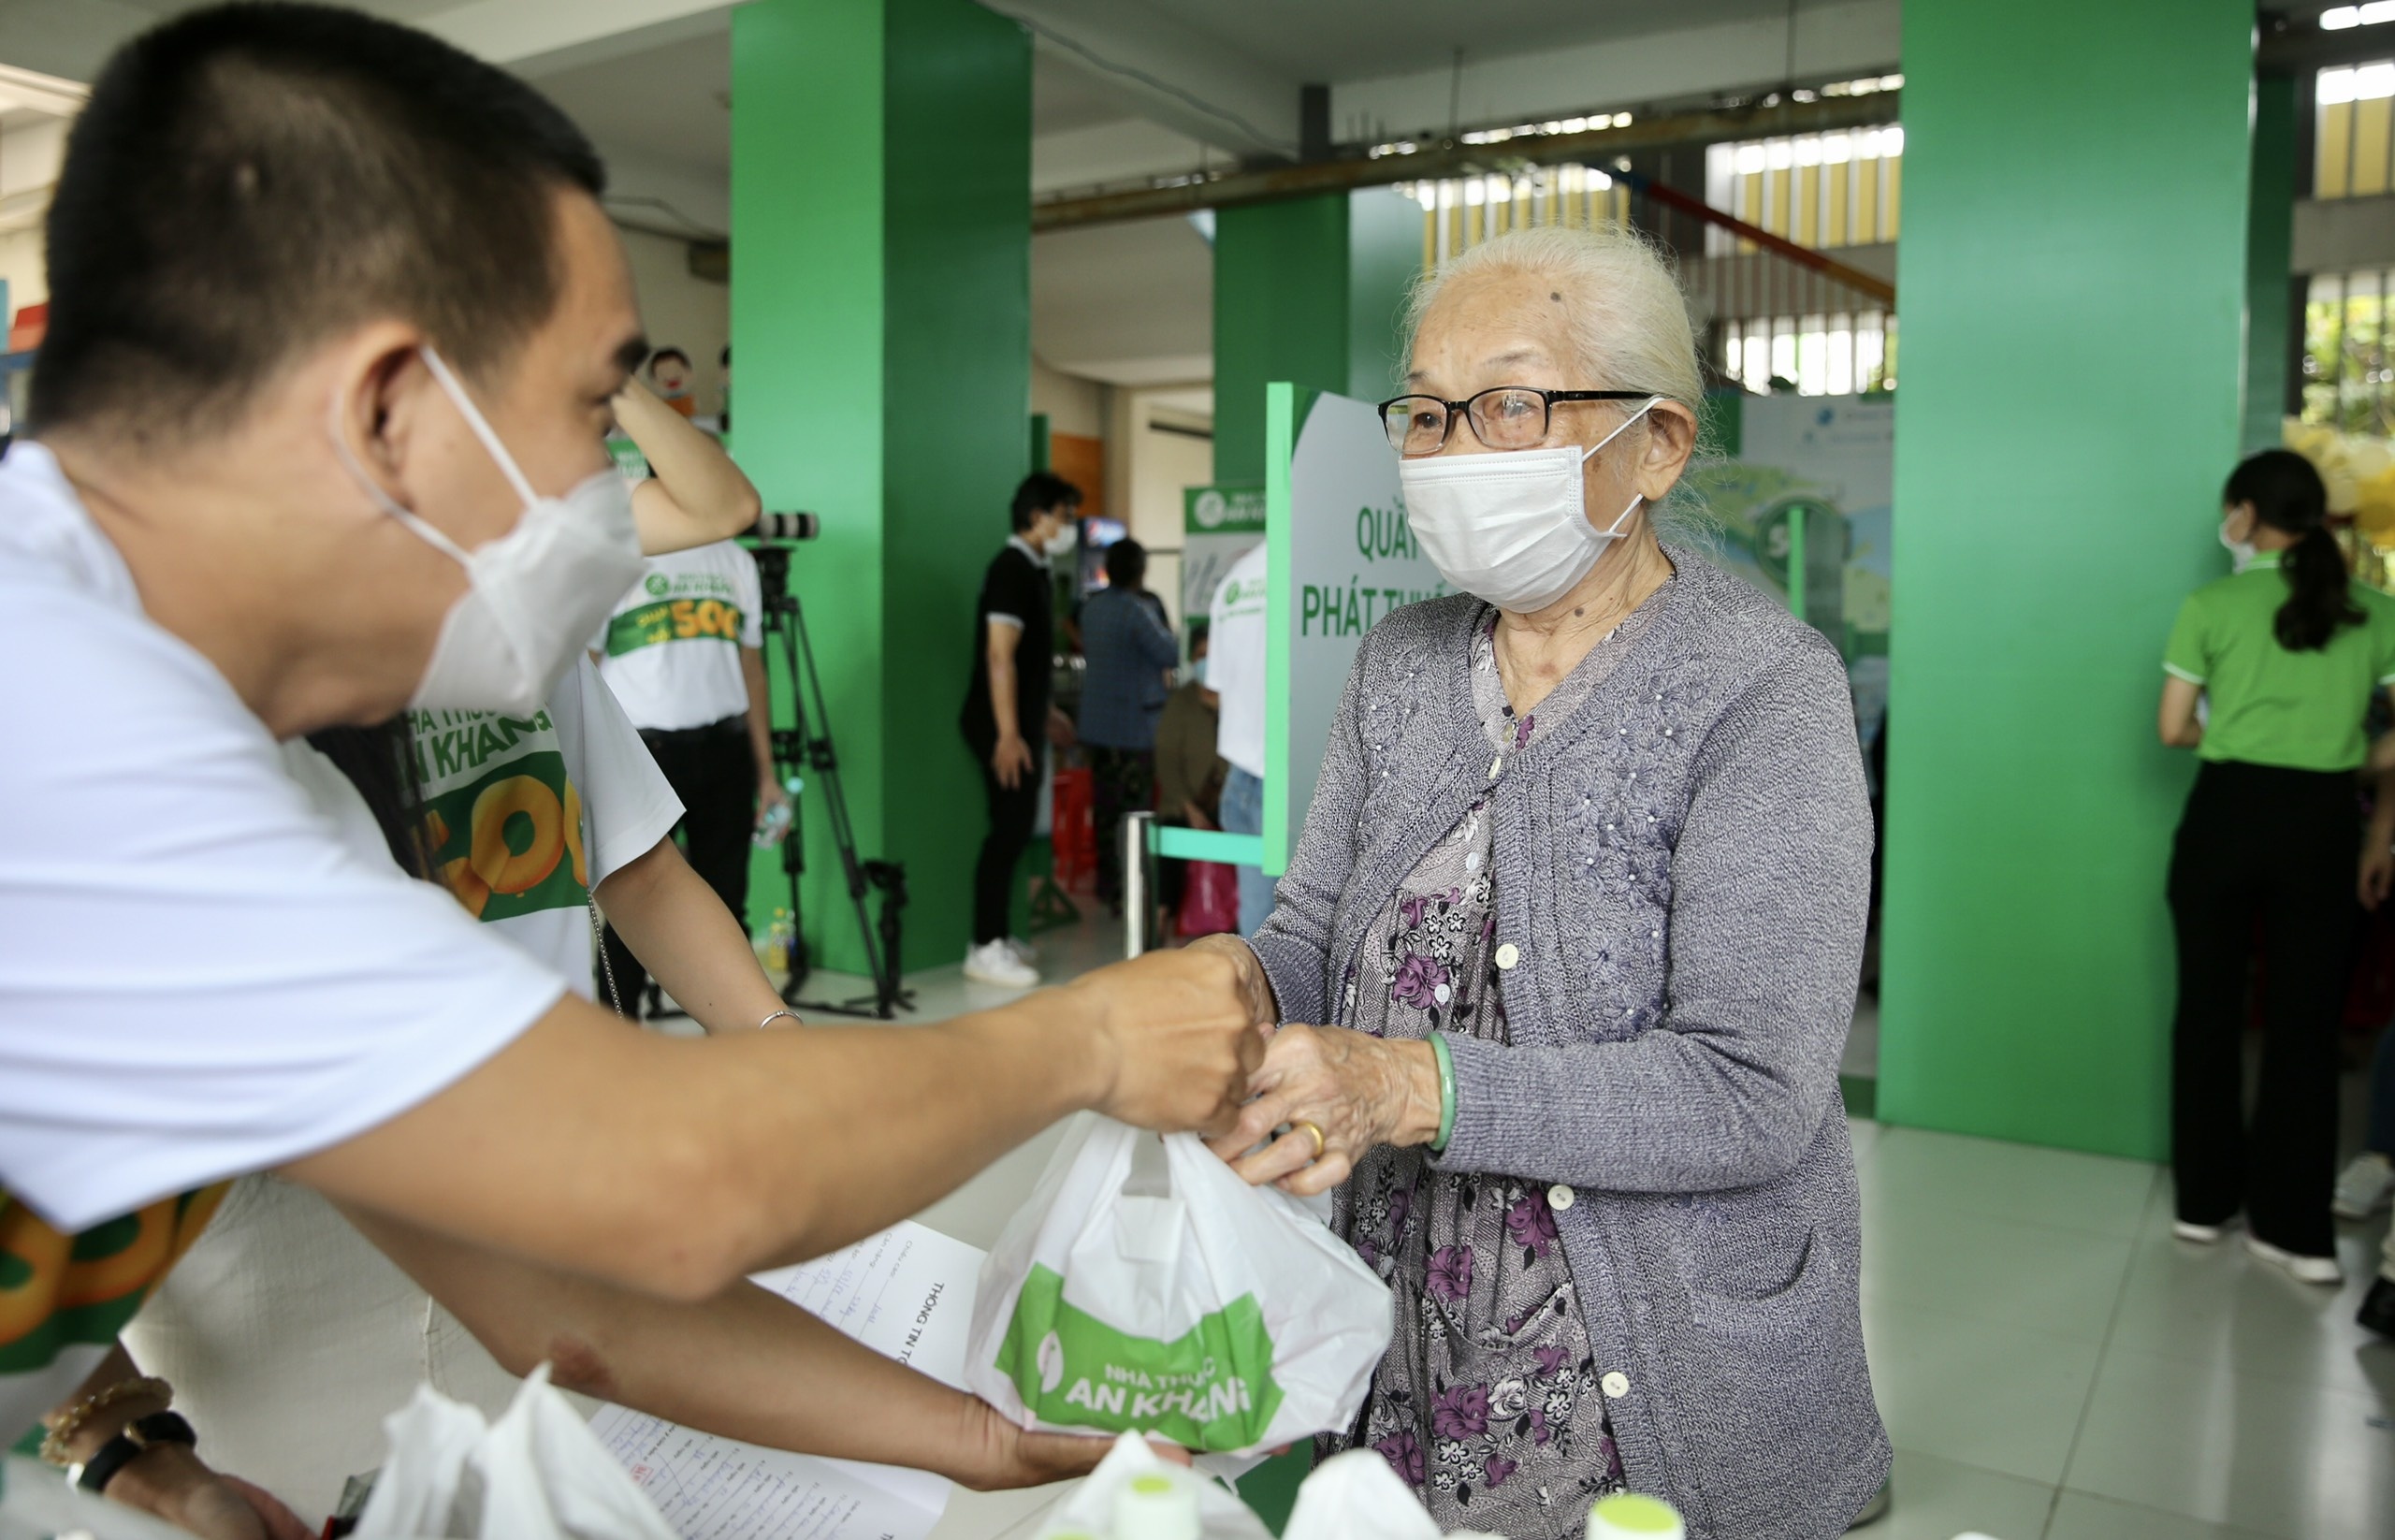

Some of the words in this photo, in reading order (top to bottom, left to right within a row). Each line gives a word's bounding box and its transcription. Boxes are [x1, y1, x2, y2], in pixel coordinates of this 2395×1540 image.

[1302, 574, 1377, 636] PHÁT
[905, 1328, 922, 1347] TIN
[1065, 1377, 1126, 1415] AN
